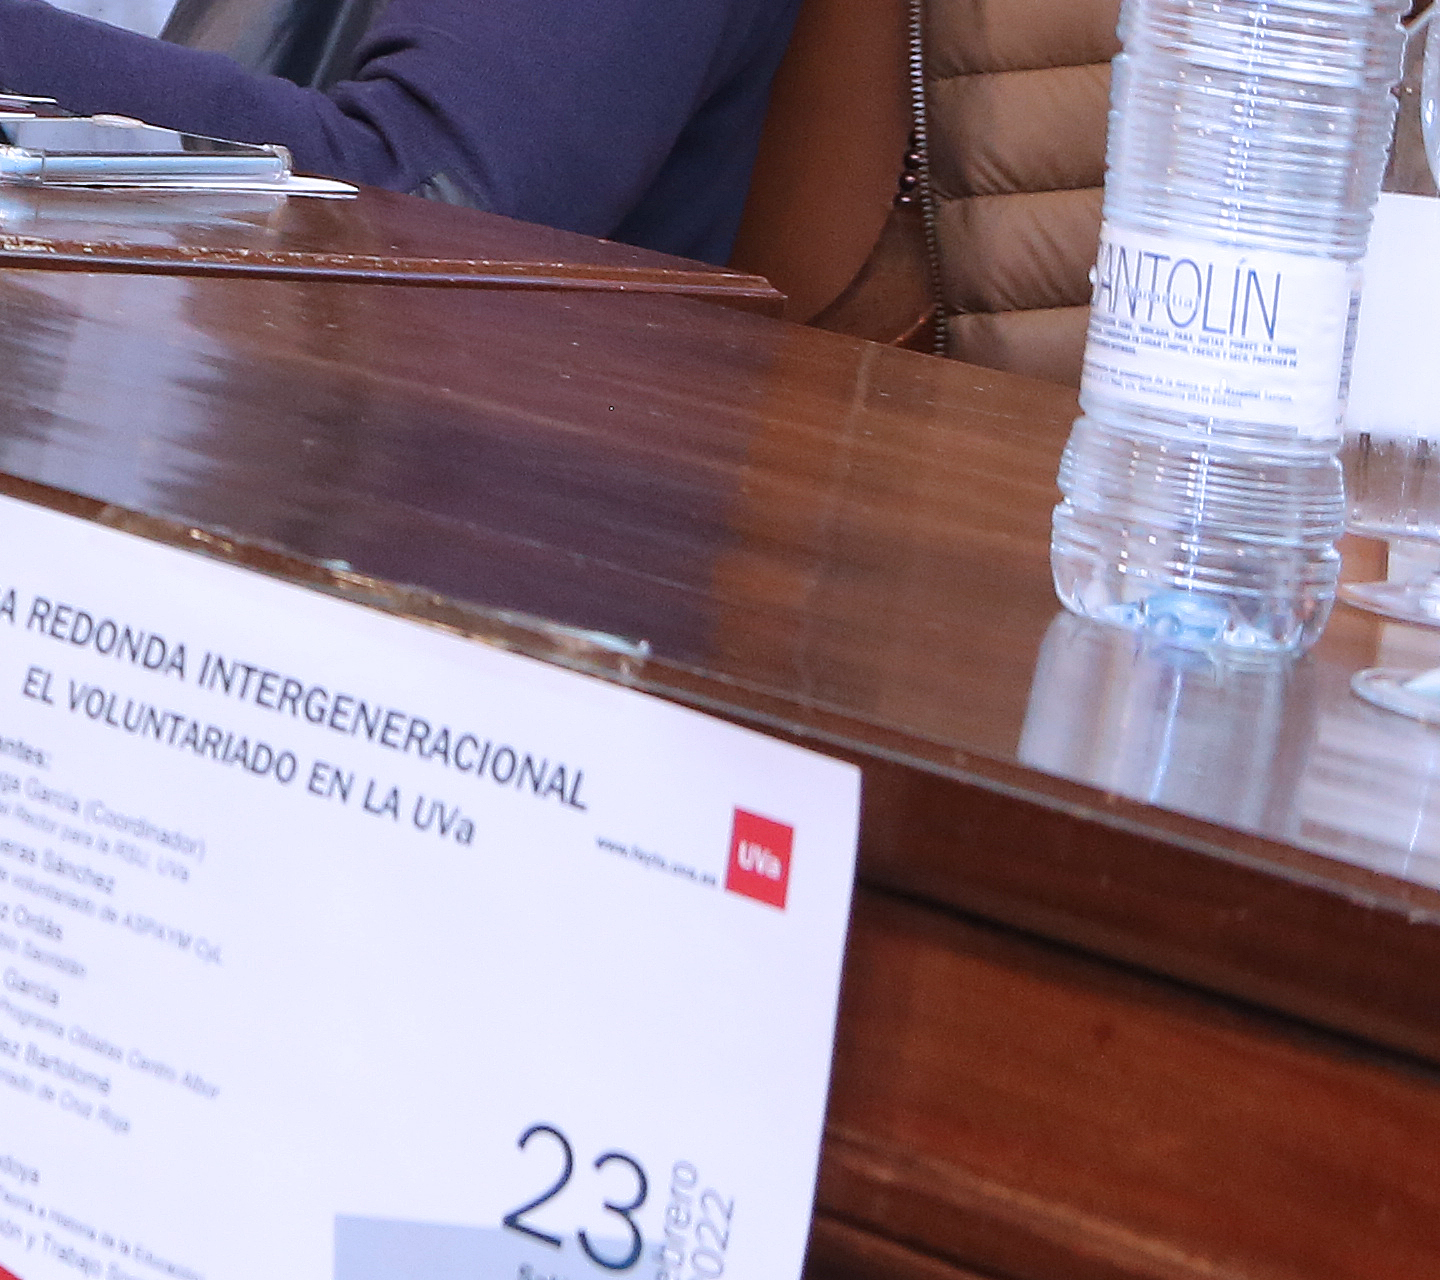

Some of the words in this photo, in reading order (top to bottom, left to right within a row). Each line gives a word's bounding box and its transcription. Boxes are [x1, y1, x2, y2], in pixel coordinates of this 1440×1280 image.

[27, 597, 185, 678] REDONDA
[200, 655, 582, 808] INTERGENERACIONAL
[22, 665, 53, 705] EL
[69, 682, 296, 782] VOLUNTARIADO
[307, 760, 353, 802] EN
[362, 779, 399, 820] LA
[412, 796, 475, 845] UVa
[24, 776, 80, 815] García
[83, 800, 205, 860] (Coordinador)
[737, 840, 781, 879] UVa
[42, 849, 115, 894] Sánchez
[3, 967, 59, 1007] García
[24, 1042, 111, 1096] Bartolomé
[503, 1122, 649, 1272] 23
[691, 1188, 735, 1278] 022
